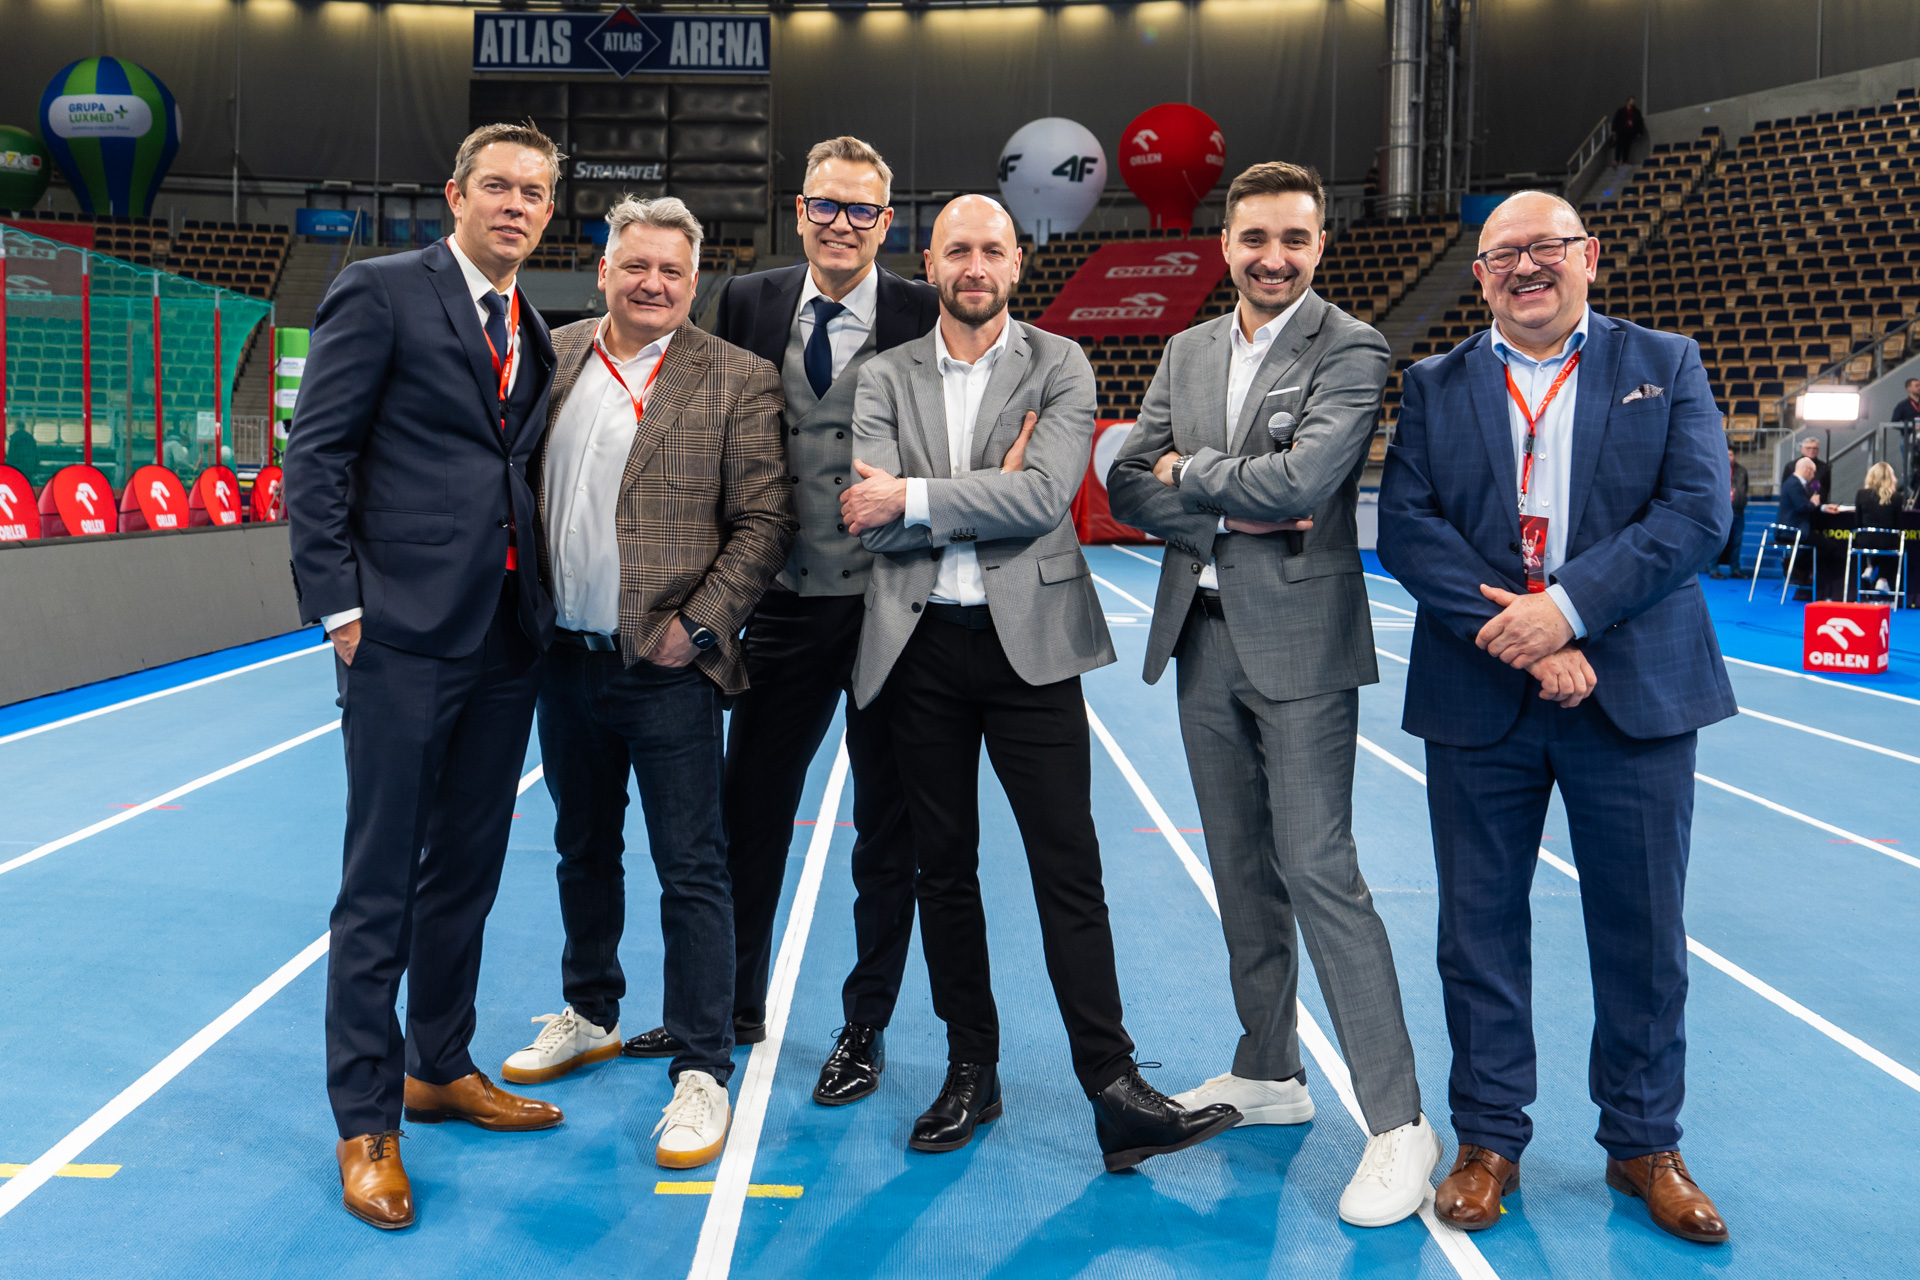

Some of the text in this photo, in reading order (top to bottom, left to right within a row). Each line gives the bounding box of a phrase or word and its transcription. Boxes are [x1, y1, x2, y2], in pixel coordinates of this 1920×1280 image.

[479, 19, 764, 66] ATLAS ARENA
[603, 32, 643, 52] ATLAS
[68, 102, 106, 113] GRUPA
[69, 112, 114, 123] LUXMED
[1130, 152, 1162, 166] ORLEN
[1052, 155, 1098, 182] 4F
[1110, 265, 1193, 277] ORLEN
[1074, 307, 1158, 319] ORLEN
[81, 519, 105, 533] ORLEN
[156, 513, 177, 527] ORLEN
[0, 524, 28, 541] ORLEN
[1809, 651, 1869, 669] ORLEN
